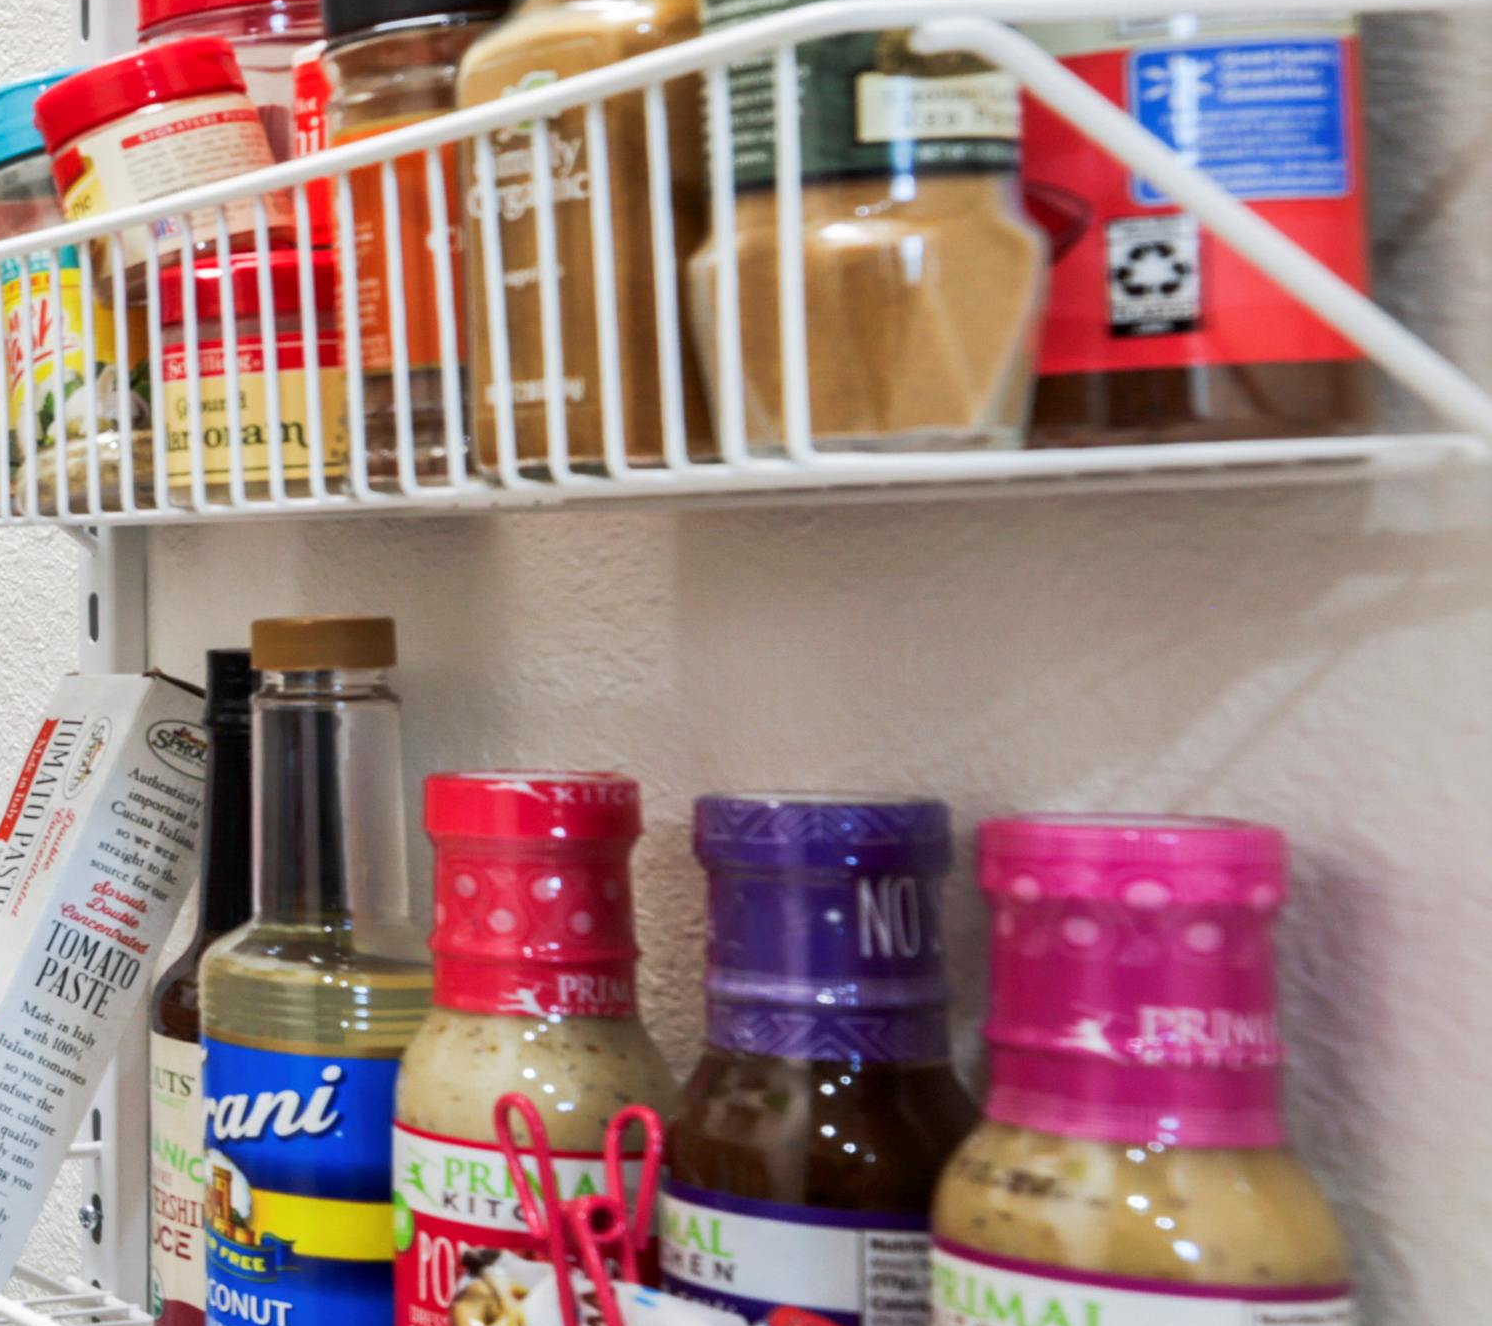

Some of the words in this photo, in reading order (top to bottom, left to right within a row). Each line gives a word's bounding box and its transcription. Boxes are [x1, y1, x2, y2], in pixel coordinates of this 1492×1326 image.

[23, 715, 87, 820] TOMATO
[128, 789, 188, 823] important
[129, 766, 203, 811] Authenticity
[111, 799, 154, 831] Cucina
[98, 839, 146, 869] straight
[147, 857, 161, 874] to
[161, 863, 179, 886] the
[115, 826, 131, 841] so
[134, 833, 151, 850] we
[154, 843, 181, 864] went
[90, 857, 129, 883] source
[132, 872, 149, 893] for
[149, 884, 171, 903] our
[92, 879, 149, 916] Sprouts
[60, 901, 151, 956] Concentrated
[86, 896, 141, 929] Double
[858, 877, 920, 958] NO
[44, 919, 142, 991] TOMATO
[20, 1000, 56, 1026] Made
[57, 1019, 71, 1034] in
[71, 1022, 98, 1049] Italy
[22, 1025, 50, 1047] with
[52, 1037, 84, 1063] 100%
[4, 1060, 21, 1075] so
[22, 1068, 44, 1089] you
[45, 1081, 66, 1099] can
[37, 1051, 89, 1088] tomatoes
[17, 1110, 58, 1138] culture
[36, 1096, 56, 1115] the
[0, 1123, 43, 1153] quality
[11, 1148, 36, 1172] into
[12, 1172, 34, 1193] you
[219, 1245, 267, 1273] FREE
